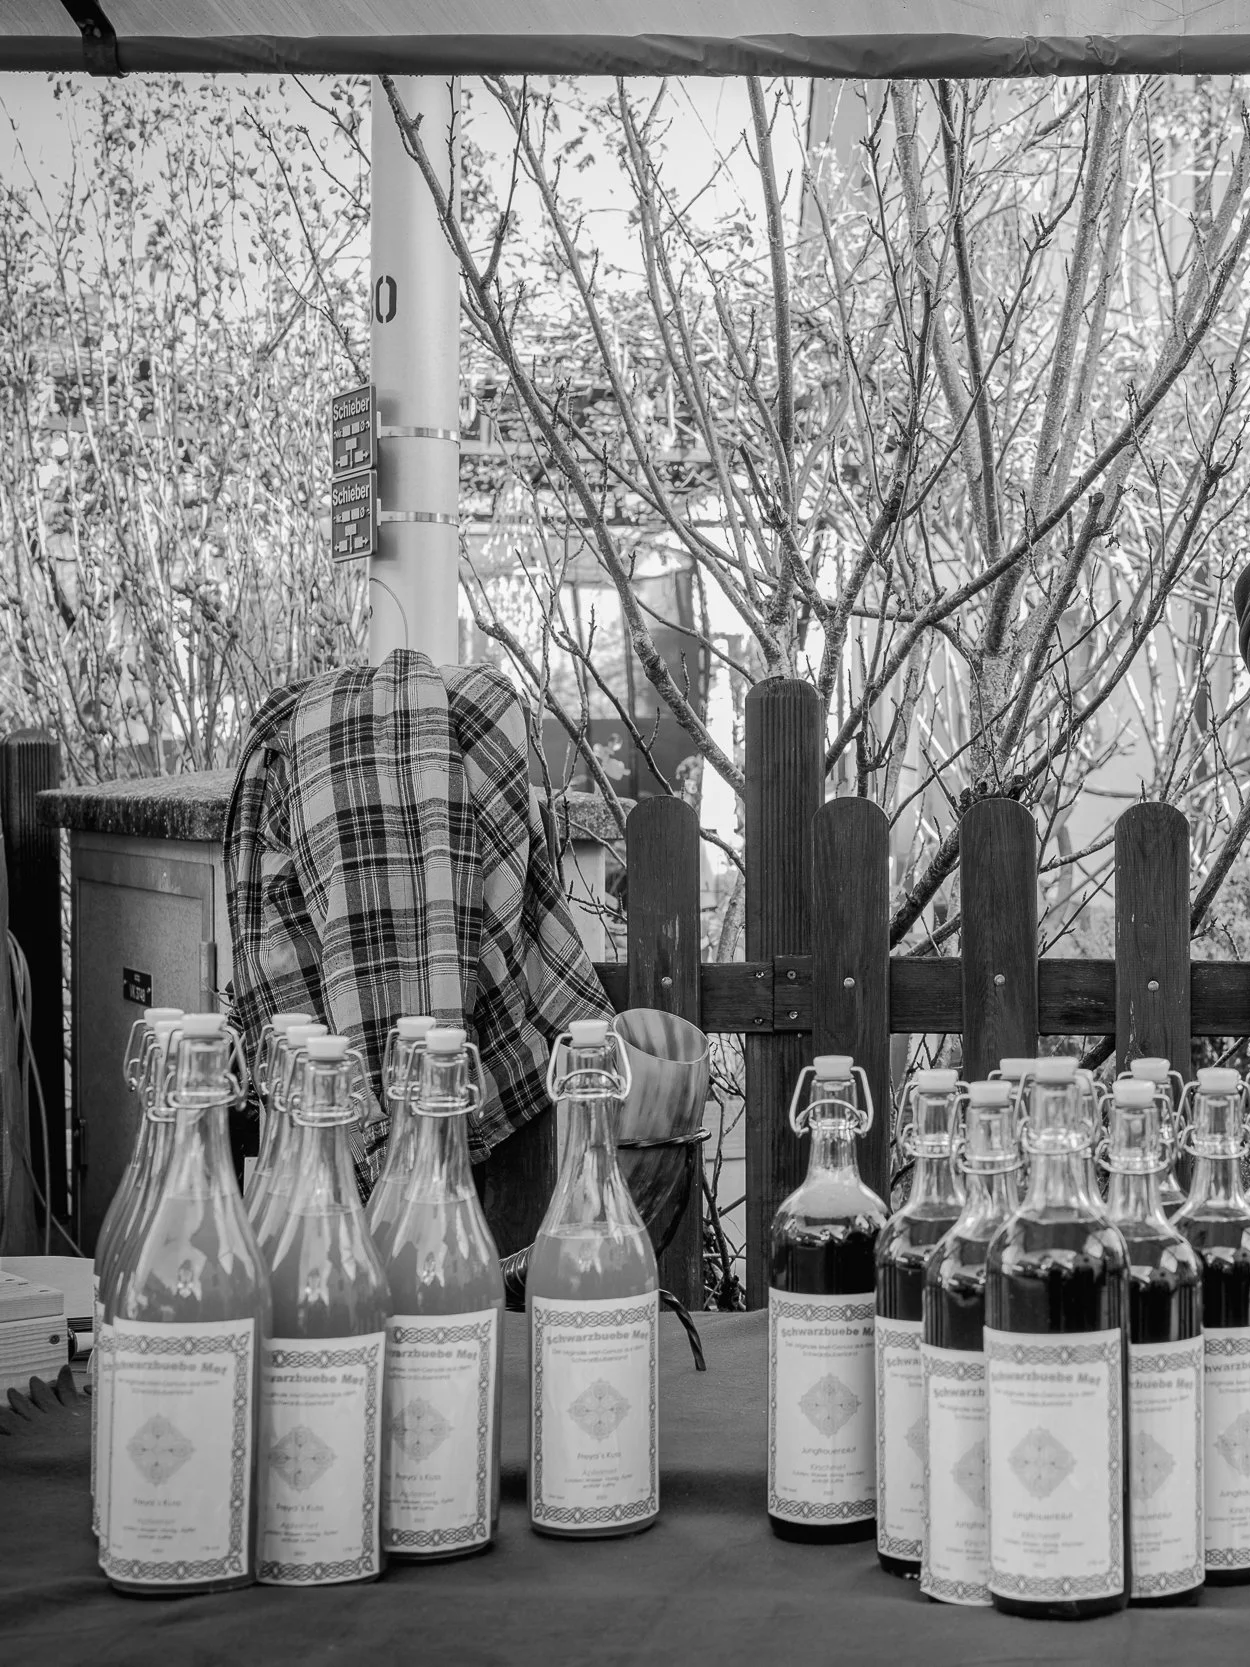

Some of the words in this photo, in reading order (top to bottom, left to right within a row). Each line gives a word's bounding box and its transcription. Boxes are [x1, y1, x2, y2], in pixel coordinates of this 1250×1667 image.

[371, 275, 397, 324] 0
[333, 397, 370, 421] Schieber
[332, 484, 370, 506] Schieber
